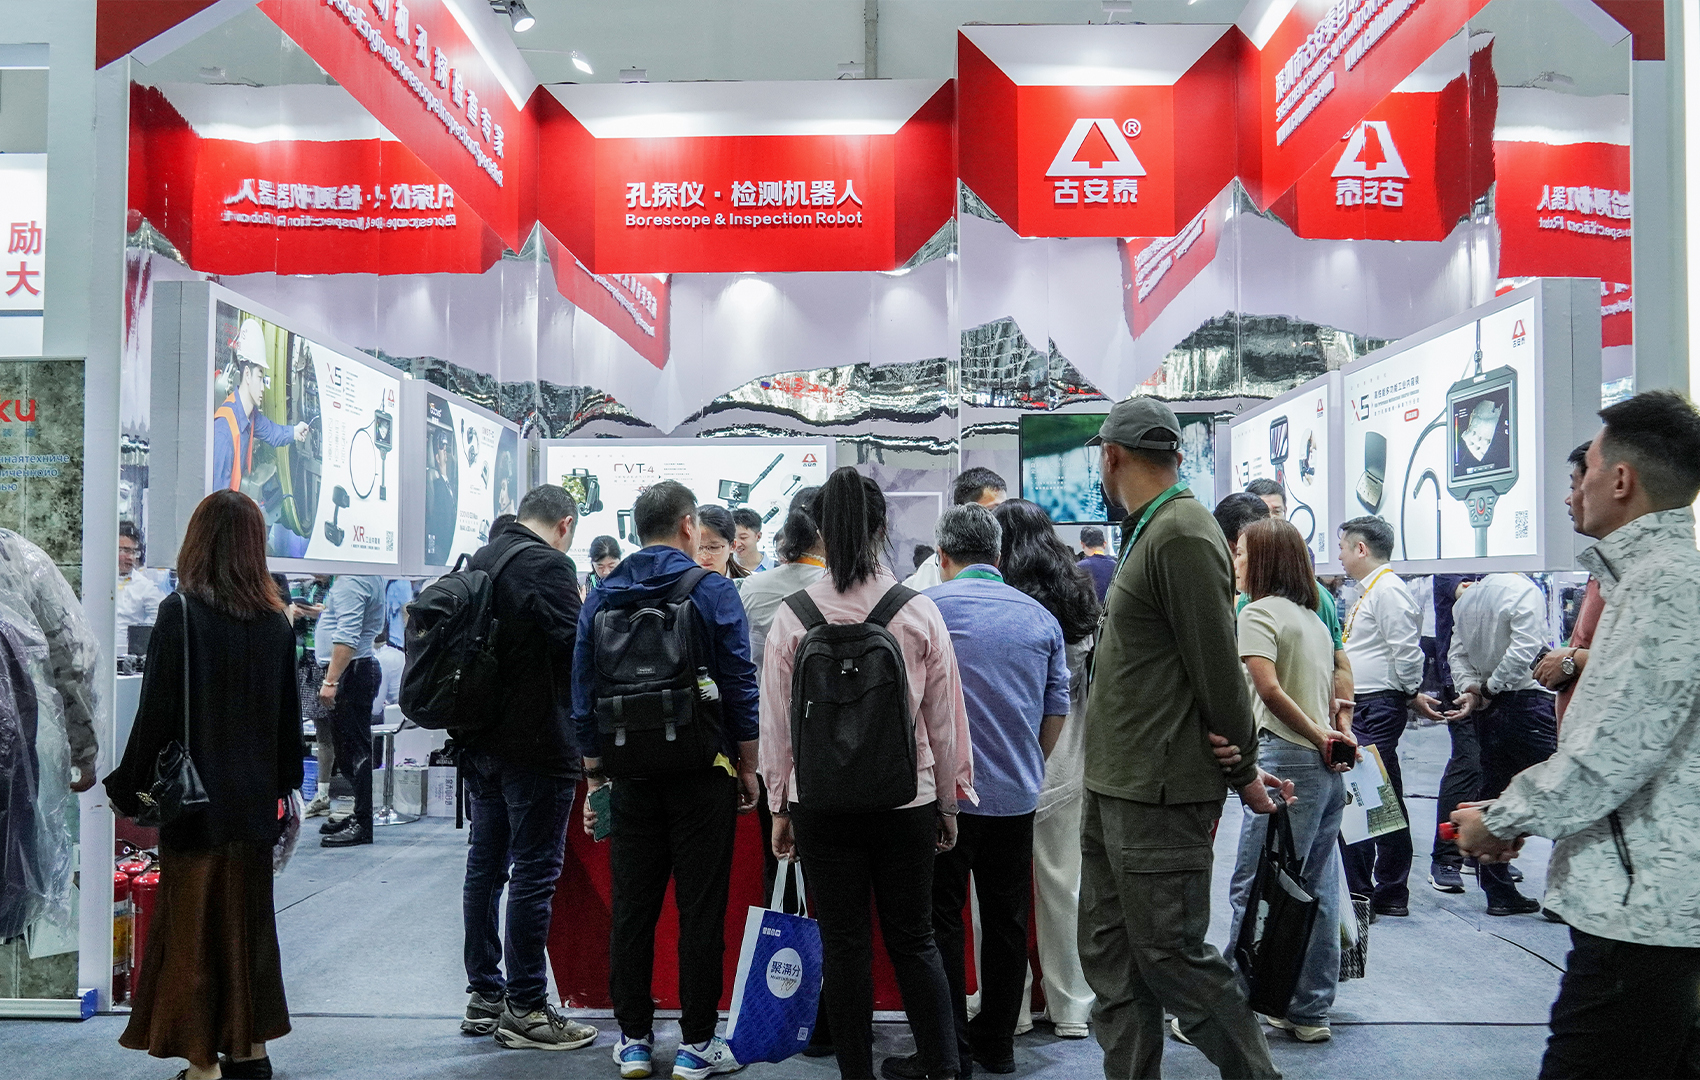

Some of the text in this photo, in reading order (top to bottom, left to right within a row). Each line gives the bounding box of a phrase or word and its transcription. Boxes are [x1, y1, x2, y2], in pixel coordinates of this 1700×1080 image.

[1054, 178, 1138, 203] 古安泰
[625, 210, 863, 228] Borescope & Inspection Robot
[771, 961, 801, 978] 聚满分
